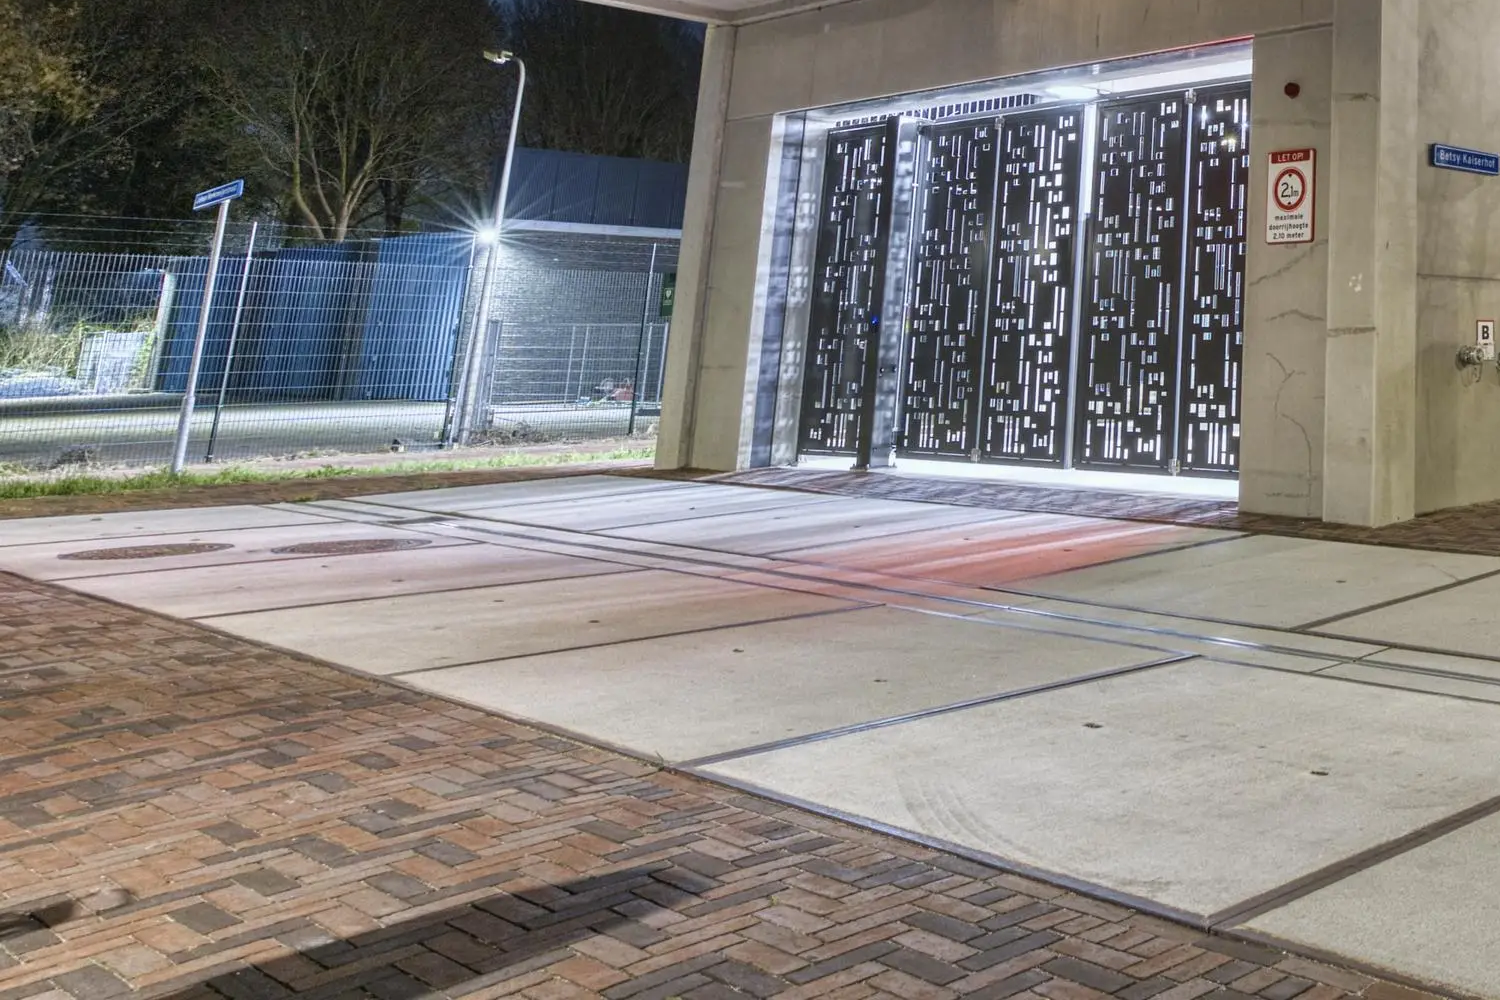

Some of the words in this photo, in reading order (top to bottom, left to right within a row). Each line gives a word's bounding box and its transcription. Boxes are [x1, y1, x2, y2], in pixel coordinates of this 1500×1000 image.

[1277, 153, 1290, 162] LET
[1440, 149, 1460, 164] Betsy
[1462, 153, 1496, 168] Kaiserhof
[1274, 213, 1304, 221] maximale
[1268, 222, 1309, 232] doorrijhoogte
[1481, 325, 1490, 340] B
